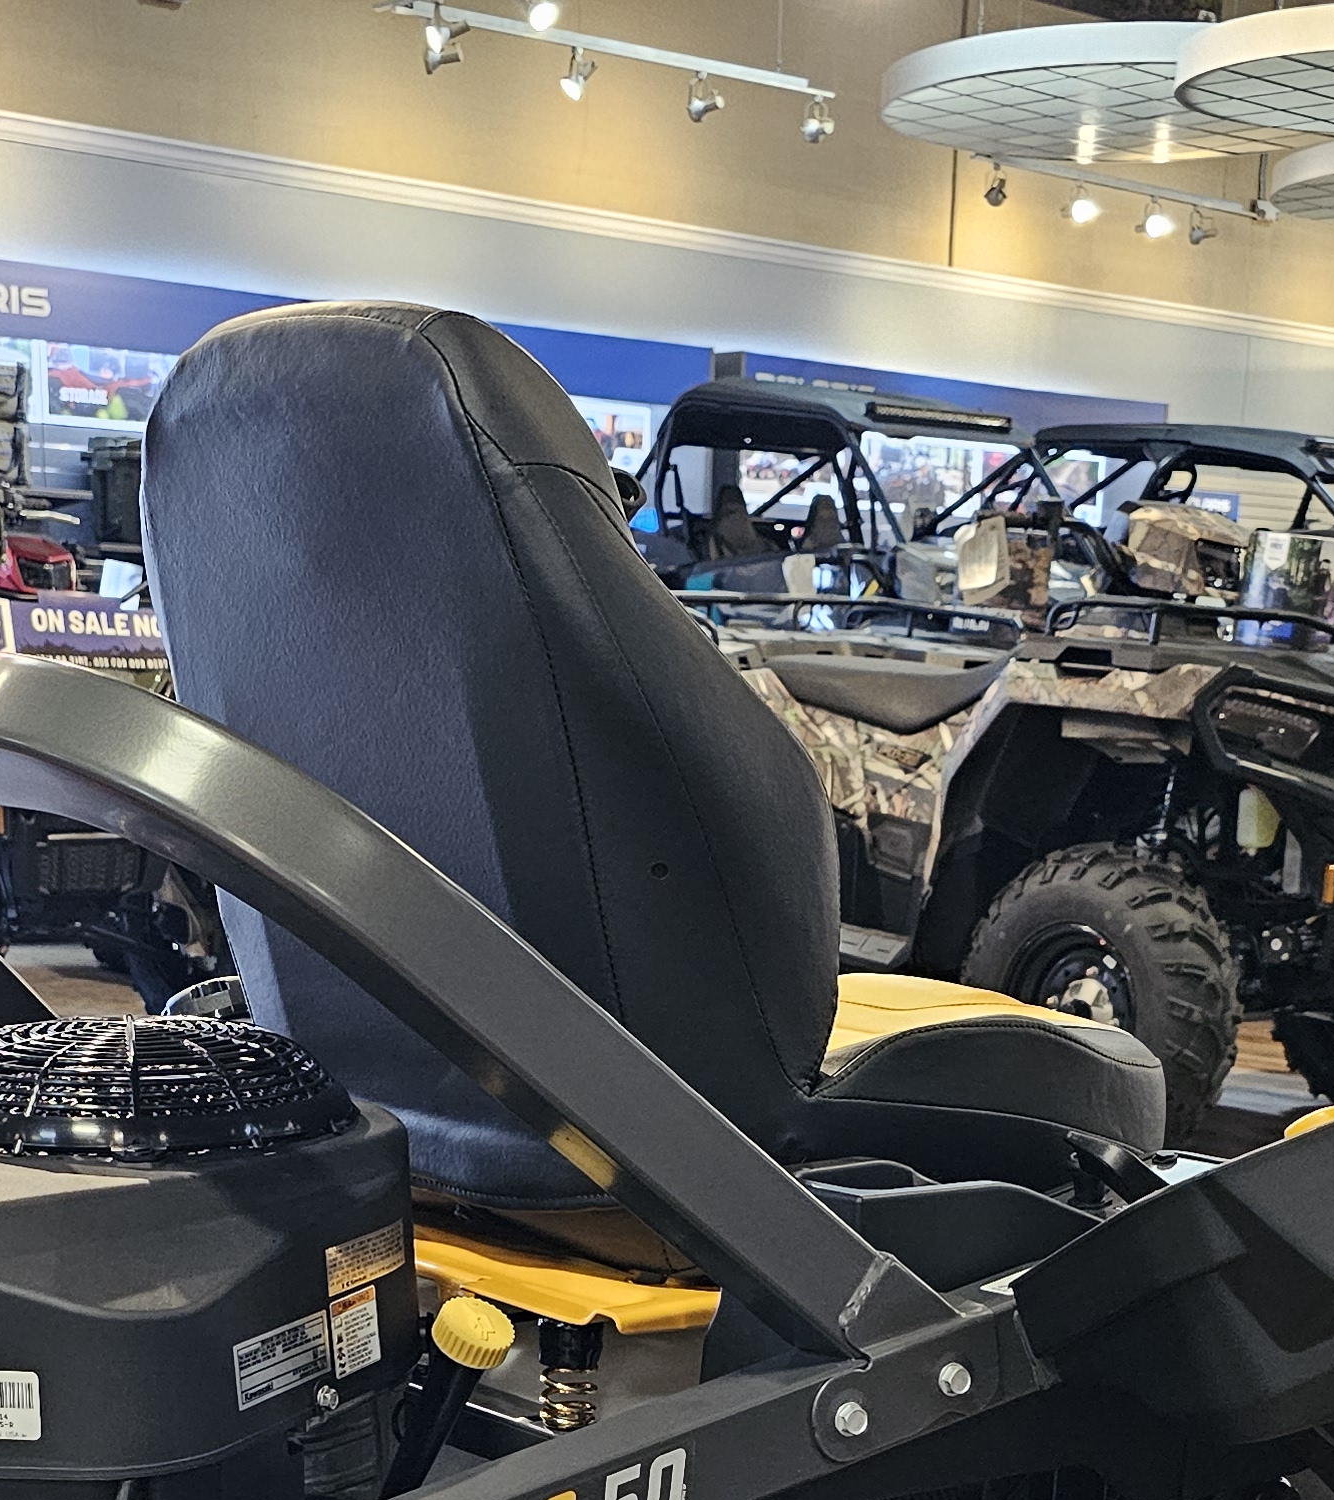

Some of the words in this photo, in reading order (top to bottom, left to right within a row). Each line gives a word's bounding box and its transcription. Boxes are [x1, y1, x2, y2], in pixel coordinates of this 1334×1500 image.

[30, 608, 66, 634] ON
[68, 610, 130, 637] SALE
[132, 613, 162, 638] NO
